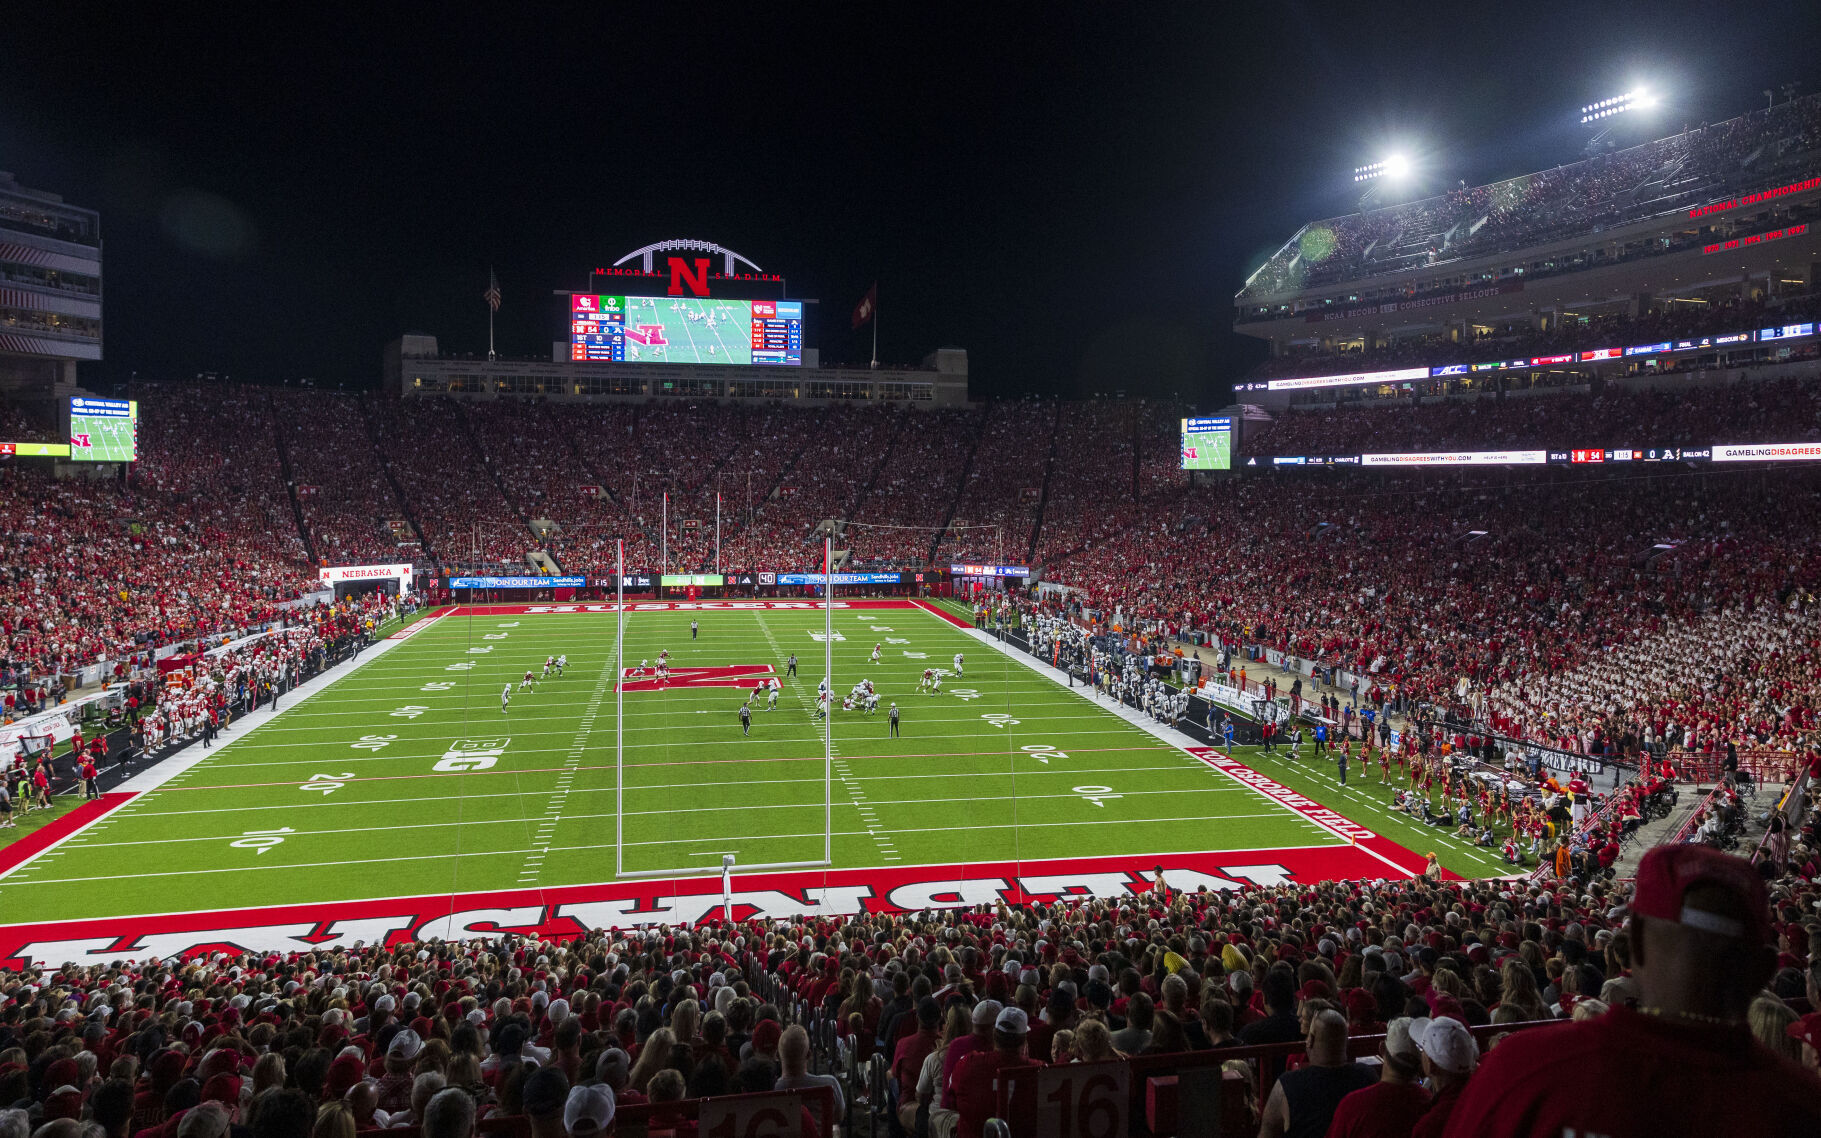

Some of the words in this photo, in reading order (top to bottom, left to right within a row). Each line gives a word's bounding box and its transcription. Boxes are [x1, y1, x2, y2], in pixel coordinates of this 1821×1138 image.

[1690, 201, 1739, 219] NATIONAL
[1704, 243, 1720, 254] 1970
[1724, 240, 1740, 250] 1971
[1744, 235, 1762, 246] 1994
[1765, 230, 1783, 241] 1995
[1787, 225, 1806, 236] 1997
[595, 267, 663, 278] MEMORIAL
[715, 272, 781, 282] STADIUM
[668, 257, 711, 296] N
[1324, 312, 1345, 321] NCAA
[1347, 306, 1378, 318] RECORD
[1400, 295, 1455, 310] CONSECUTIVE
[1458, 288, 1500, 301] SELLOUTS
[1440, 365, 1462, 376] ACC
[1590, 451, 1600, 460] 54
[1649, 450, 1656, 459] 0
[342, 568, 392, 577] NEBRASKA
[760, 574, 773, 583] 40
[817, 575, 834, 583] JON
[916, 574, 924, 582] N
[430, 578, 439, 587] N
[492, 578, 512, 587] JOIN
[512, 578, 528, 586] OUR
[529, 578, 550, 586] TEAM
[623, 576, 633, 587] N
[524, 602, 851, 613] HUSKERS
[389, 705, 430, 718] 40
[980, 713, 1021, 726] 30
[350, 734, 398, 749] 30
[1020, 744, 1069, 760] 20
[299, 772, 356, 791] 20
[1072, 785, 1124, 799] 10
[1194, 750, 1242, 767] TOM
[1228, 767, 1318, 808] OSBORNE
[1306, 808, 1377, 840] FIELD
[230, 827, 296, 848] 10
[1046, 1073, 1121, 1138] 16
